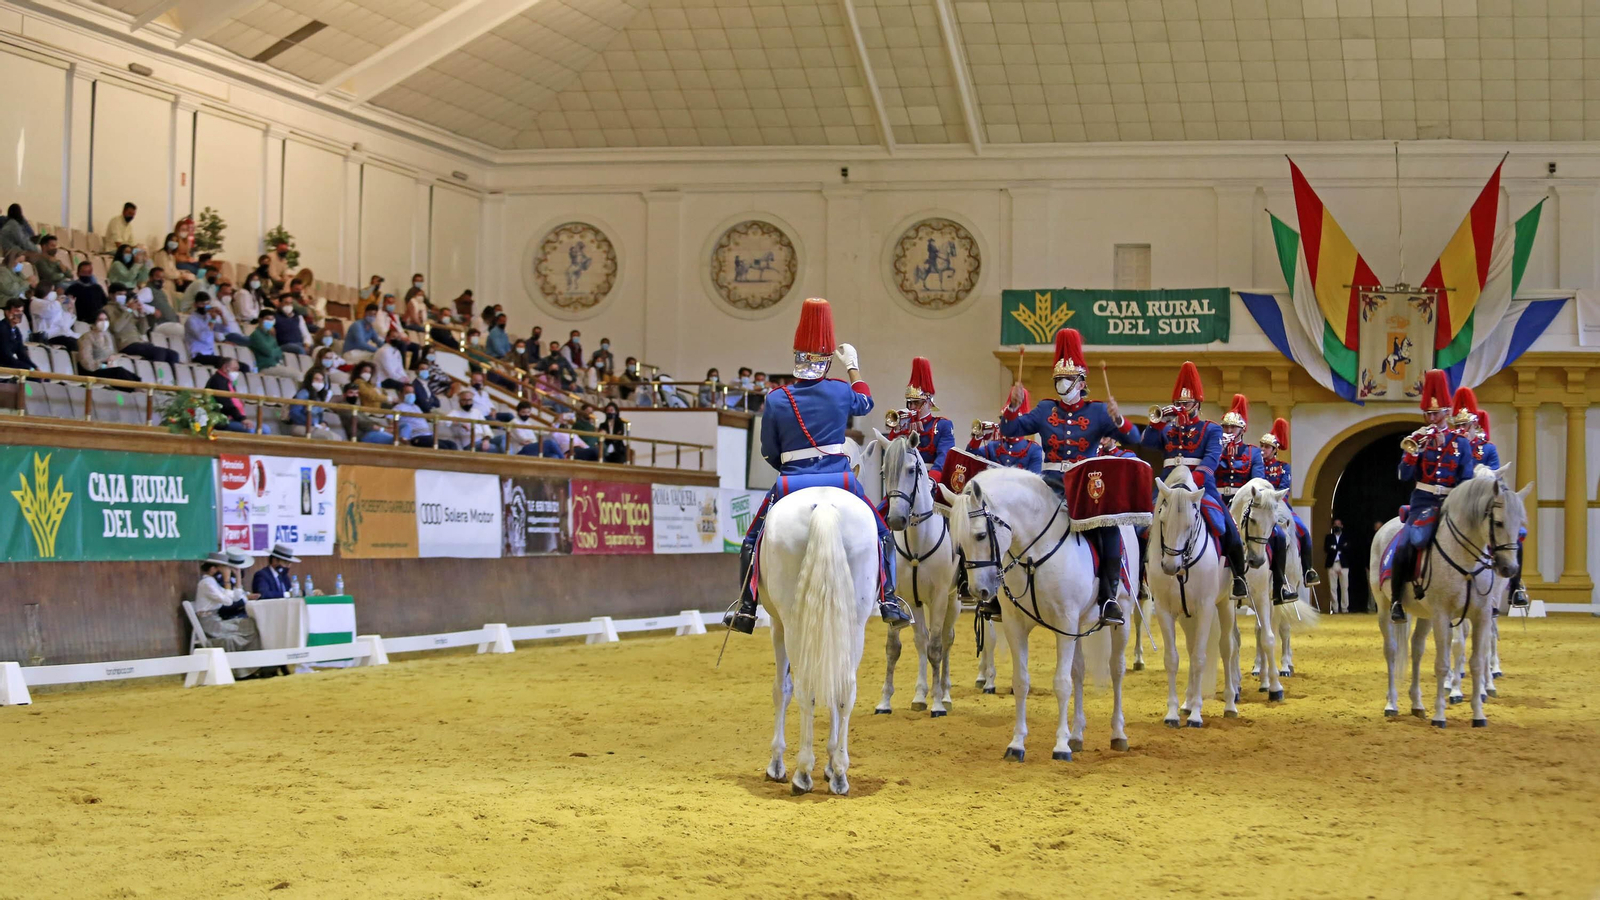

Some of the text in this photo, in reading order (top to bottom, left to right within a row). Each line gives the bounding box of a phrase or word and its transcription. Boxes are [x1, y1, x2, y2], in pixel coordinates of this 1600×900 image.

[1092, 299, 1215, 318] CAJA RURAL
[1107, 318, 1201, 335] DEL SUR
[88, 471, 189, 505] CAJA RURAL
[102, 509, 181, 538] DEL SUR
[444, 506, 494, 523] Solera Motor
